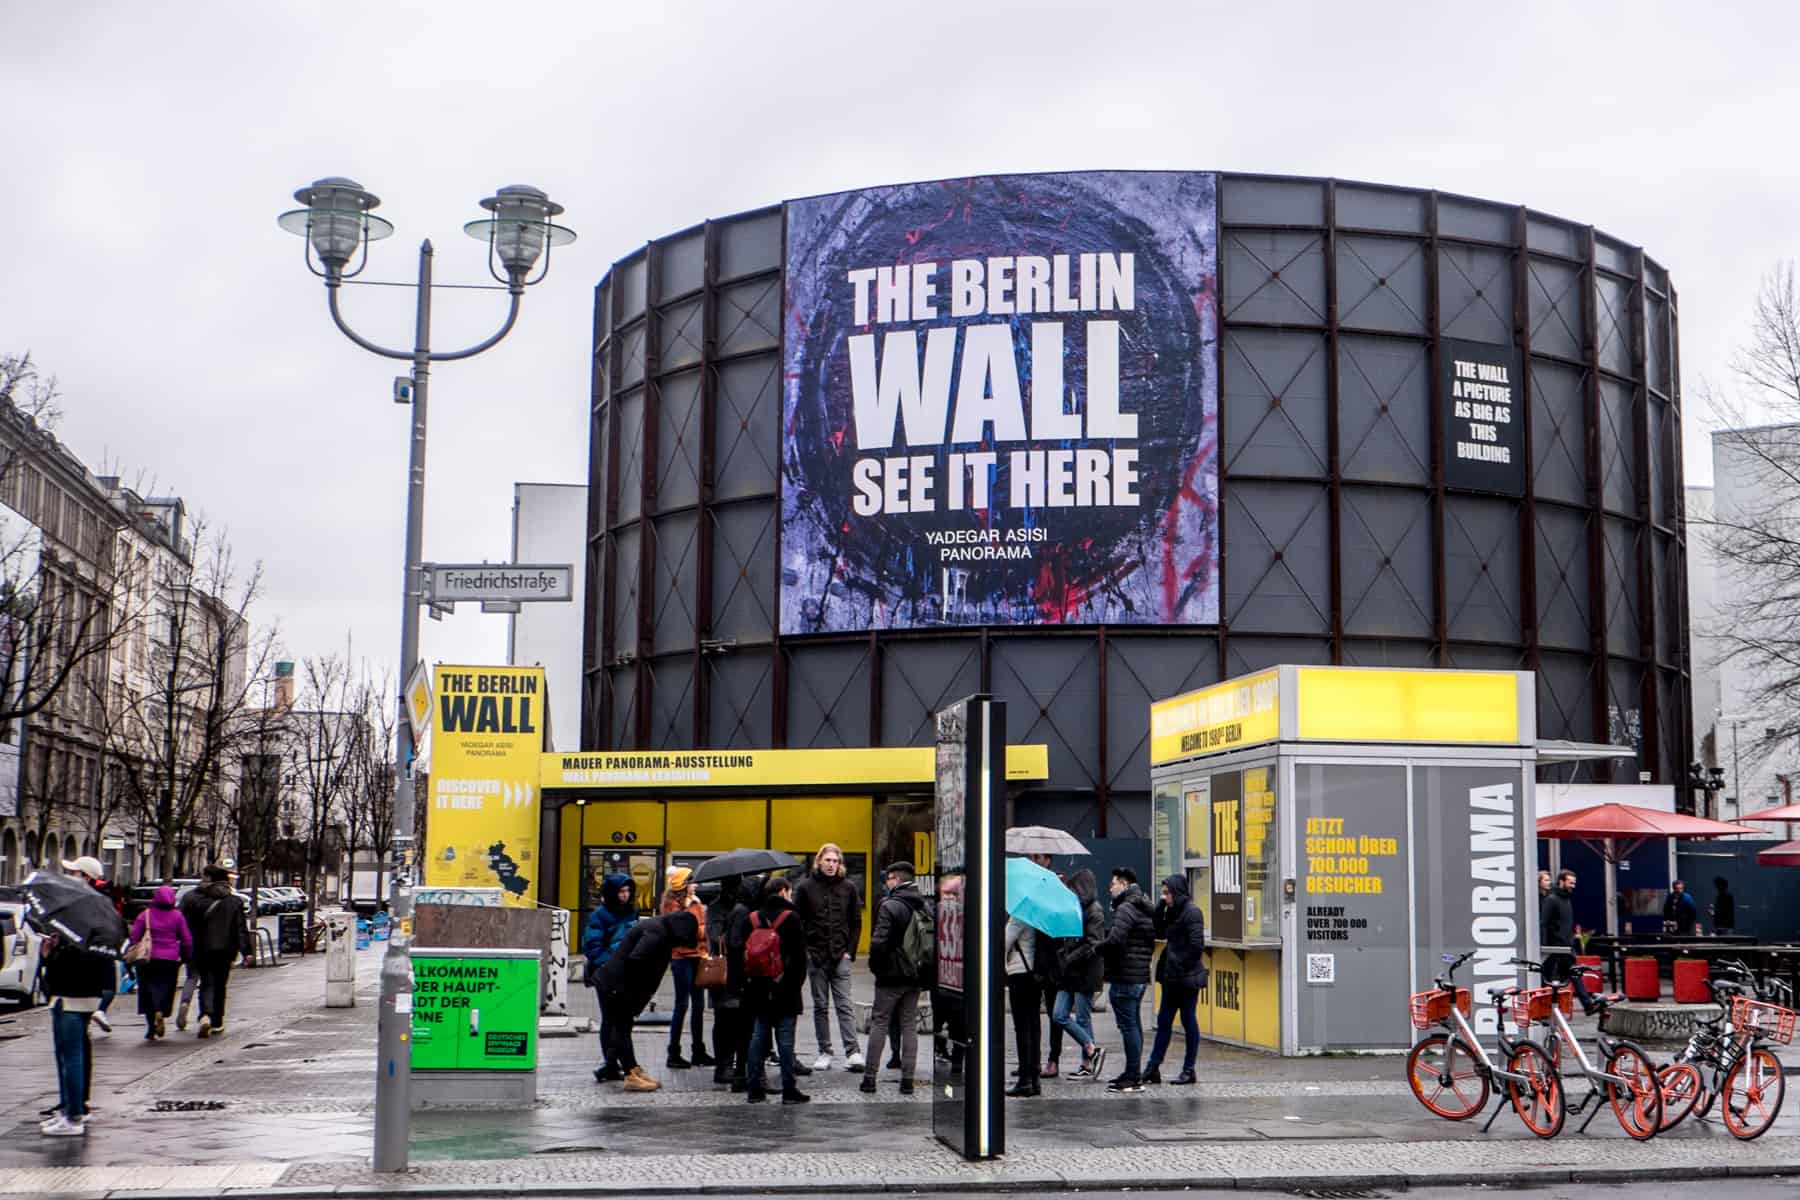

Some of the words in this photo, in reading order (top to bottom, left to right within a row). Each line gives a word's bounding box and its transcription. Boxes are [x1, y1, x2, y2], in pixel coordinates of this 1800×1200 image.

[847, 262, 938, 326] THE
[951, 253, 1135, 317] BERLIN
[1454, 360, 1477, 379] THE
[1477, 364, 1510, 383] WALL
[848, 320, 1139, 450] WALL
[1452, 380, 1463, 397] A
[1463, 382, 1512, 404] PICTURE
[1455, 401, 1472, 418] AS
[1472, 403, 1493, 421] BIG
[1495, 406, 1511, 423] AS
[1469, 423, 1497, 441] THIS
[1456, 441, 1511, 464] BUILDING
[853, 455, 936, 516] SEE
[948, 452, 997, 510] IT
[1010, 449, 1140, 508] HERE
[925, 530, 1001, 545] YADEGAR
[1006, 528, 1048, 542] ASISI
[940, 546, 1032, 561] PANORAMA
[445, 571, 557, 592] Friedrichstraße
[441, 674, 473, 692] THE
[477, 675, 537, 694] BERLIN
[440, 695, 536, 733] WALL
[562, 757, 602, 769] MAUER
[606, 755, 753, 769] PANORAMA-AUSSTELLUNG
[1213, 800, 1239, 853] THE
[1305, 818, 1344, 834] JETZT
[1305, 837, 1357, 854] SCHON
[1359, 834, 1397, 855] ÜBER
[1213, 854, 1241, 894] WALL
[1308, 857, 1369, 874] 700.000
[1305, 876, 1383, 894] BESUCHER
[1306, 906, 1345, 917] ALREADY
[1469, 783, 1518, 1035] PANORAMA
[1306, 918, 1330, 928] OVER
[1332, 918, 1349, 928] 700
[1350, 918, 1368, 928] 000
[1306, 929, 1349, 940] VISITORS
[443, 982, 502, 993] HAUPT-
[1215, 970, 1240, 1011] HERE
[441, 997, 471, 1008] DER
